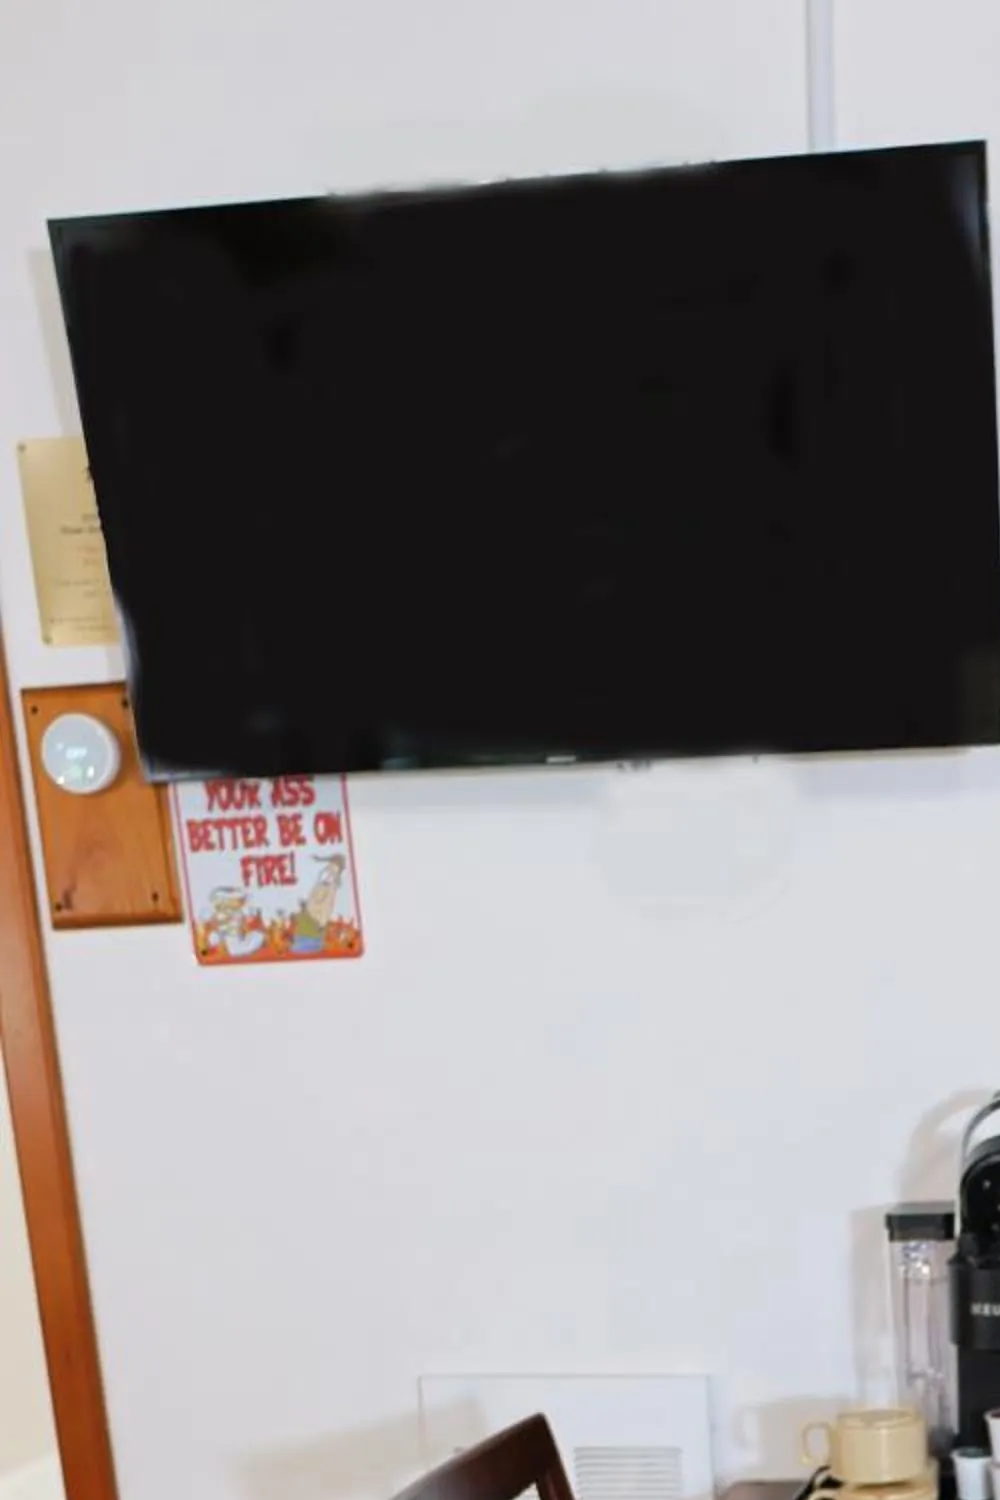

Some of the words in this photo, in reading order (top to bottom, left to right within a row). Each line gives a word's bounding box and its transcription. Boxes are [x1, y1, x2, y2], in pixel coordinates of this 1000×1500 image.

[204, 777, 261, 812] YOUR
[271, 774, 316, 807] ASS
[186, 815, 269, 852] BETTER
[277, 813, 305, 847] BE
[313, 811, 343, 844] ON
[240, 851, 297, 889] FIRE!
